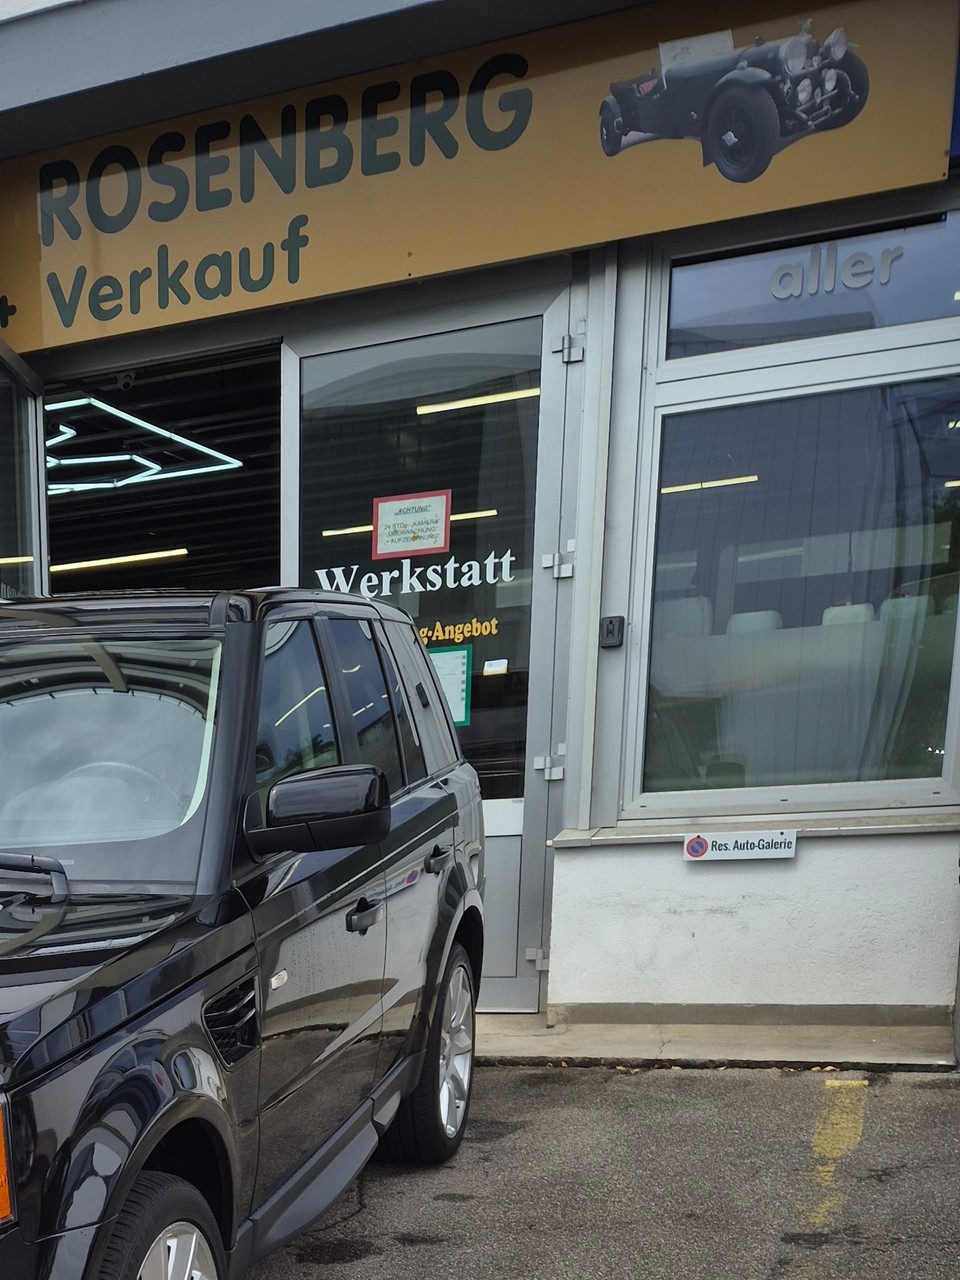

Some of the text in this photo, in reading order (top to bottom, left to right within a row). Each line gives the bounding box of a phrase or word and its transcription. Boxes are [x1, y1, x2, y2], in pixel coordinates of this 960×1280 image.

[40, 52, 533, 247] ROSENBERG
[46, 214, 310, 329] Verkauf
[770, 242, 904, 299] aller
[315, 549, 516, 599] Werkstatt
[711, 838, 793, 851] Res. Auto-Galerie
